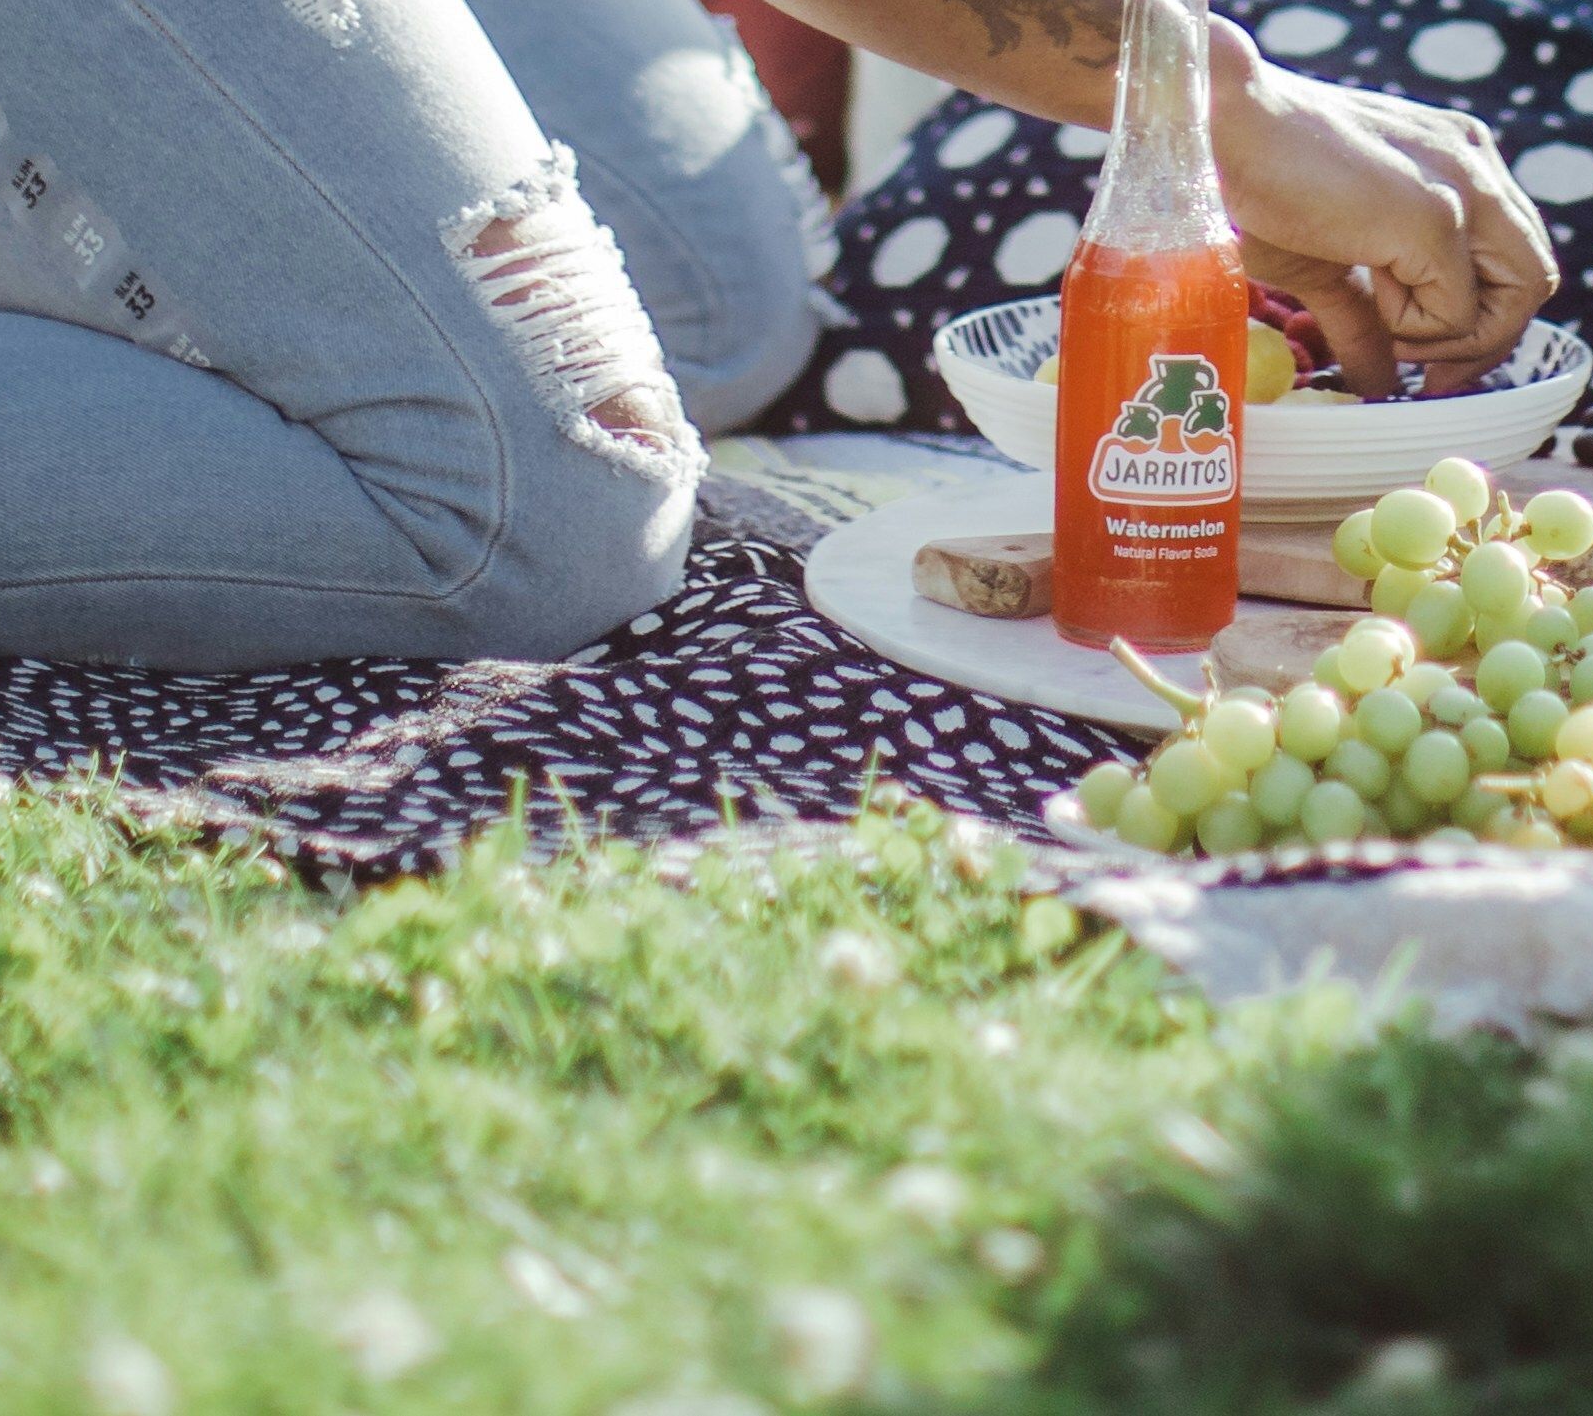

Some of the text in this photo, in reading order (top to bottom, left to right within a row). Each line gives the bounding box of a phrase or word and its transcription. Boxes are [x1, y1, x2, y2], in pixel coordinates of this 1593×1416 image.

[12, 159, 35, 189] SLIM
[23, 172, 47, 209] 33
[64, 214, 88, 246] SLIM
[75, 227, 105, 265] 33
[113, 270, 140, 300] SLIM
[125, 284, 155, 320] 33
[1105, 457, 1227, 486] JARRITOS
[1105, 516, 1226, 539] Watermelon
[1113, 545, 1219, 560] Natural Flavor Soda
